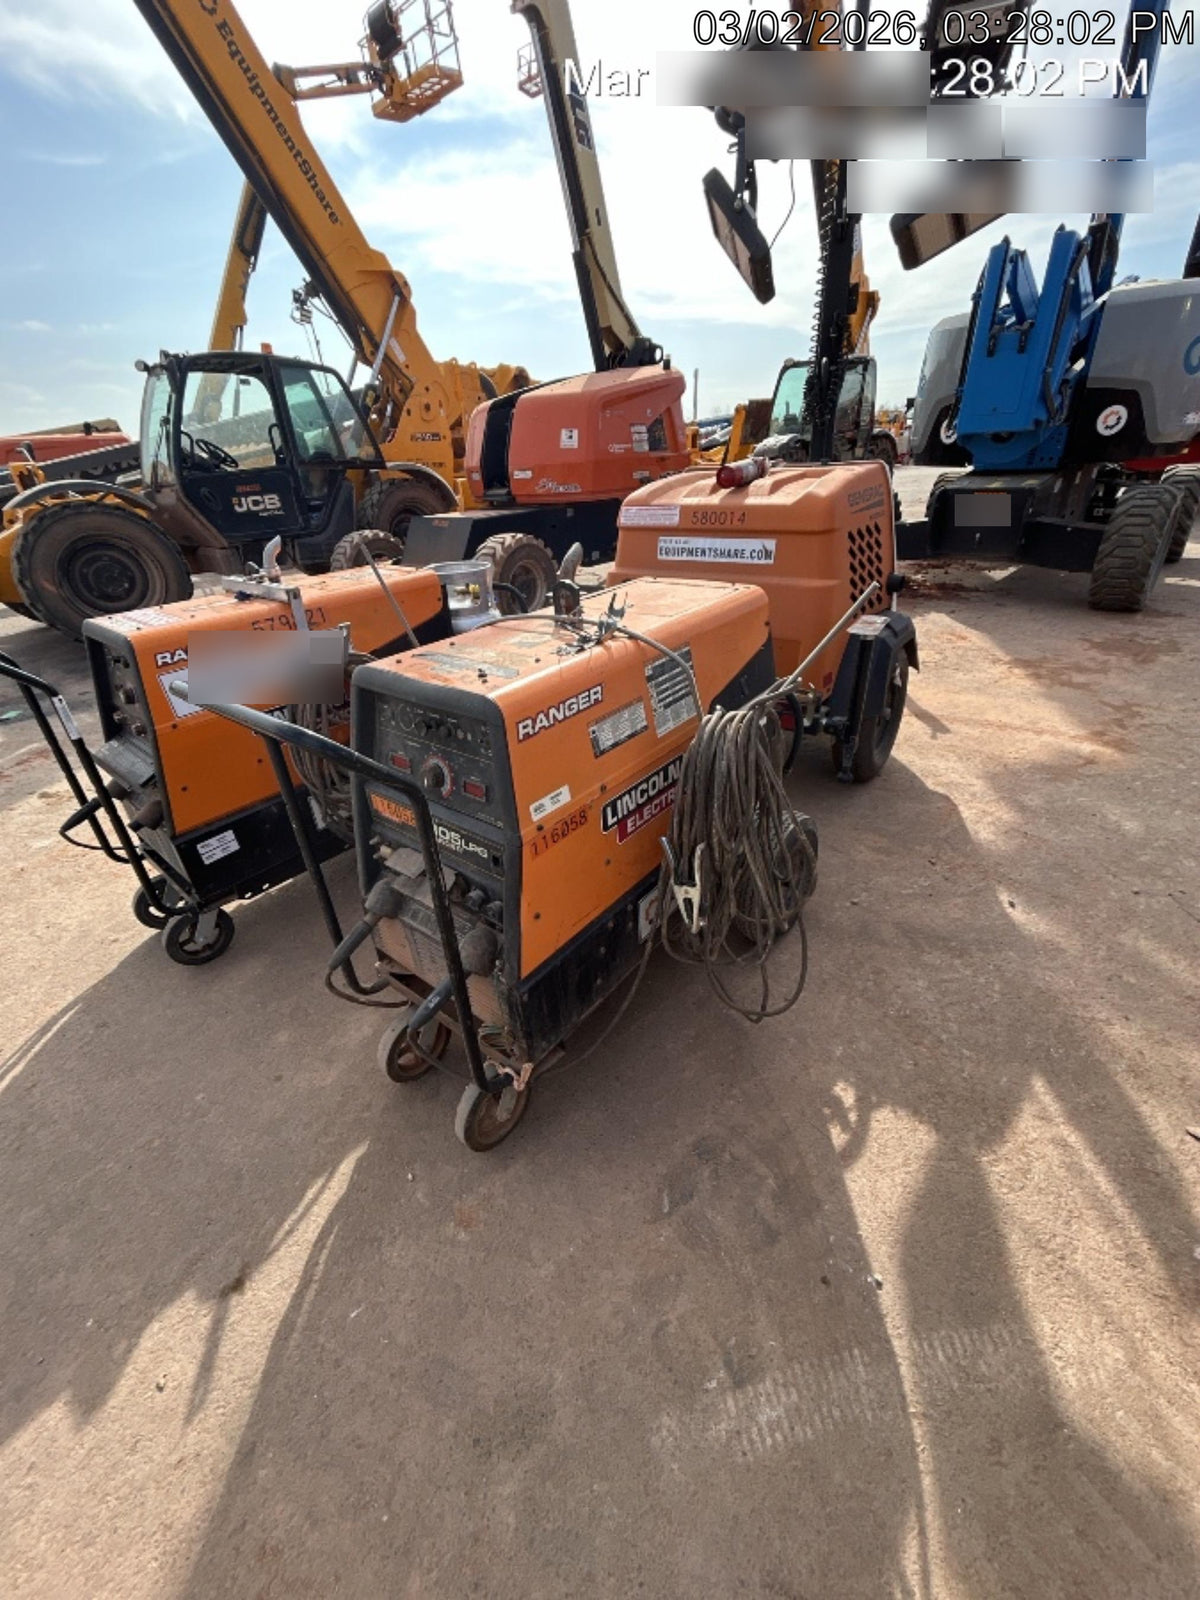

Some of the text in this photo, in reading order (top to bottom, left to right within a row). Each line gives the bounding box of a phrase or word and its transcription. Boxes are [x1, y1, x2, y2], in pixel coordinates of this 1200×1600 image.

[215, 18, 340, 226] EquipmentShare
[233, 493, 282, 513] JCB
[691, 510, 747, 527] 580014
[658, 544, 774, 562] EQUIPMENTSHARE.COM
[517, 685, 604, 742] RANGER
[530, 809, 589, 857] 116058
